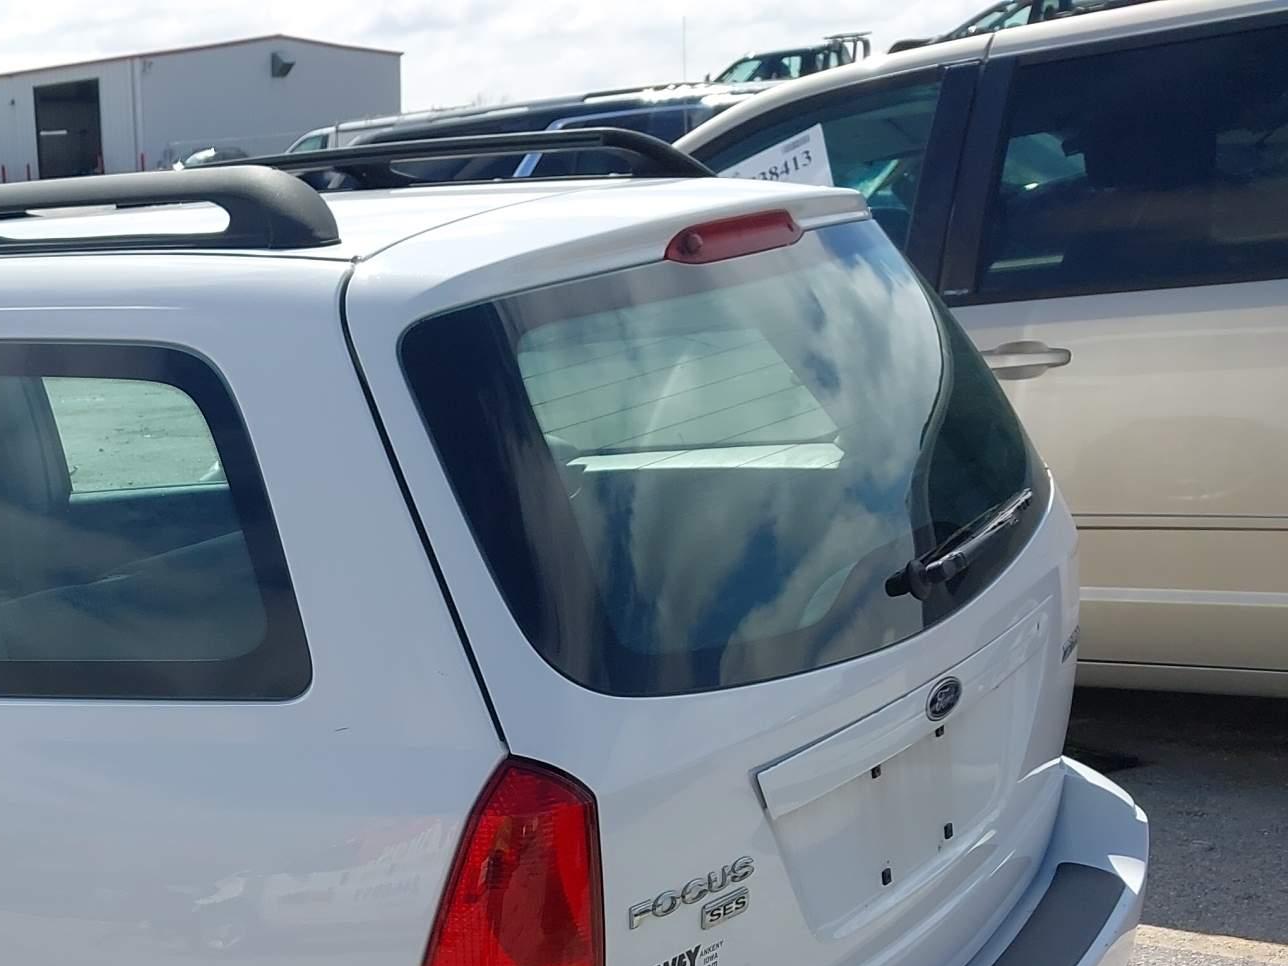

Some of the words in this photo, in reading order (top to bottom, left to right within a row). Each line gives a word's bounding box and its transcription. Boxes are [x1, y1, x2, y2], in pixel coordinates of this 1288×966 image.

[628, 855, 755, 930] FOCUS
[708, 895, 747, 923] SES
[699, 940, 724, 958] ANKENY
[703, 952, 719, 965] IOWA
